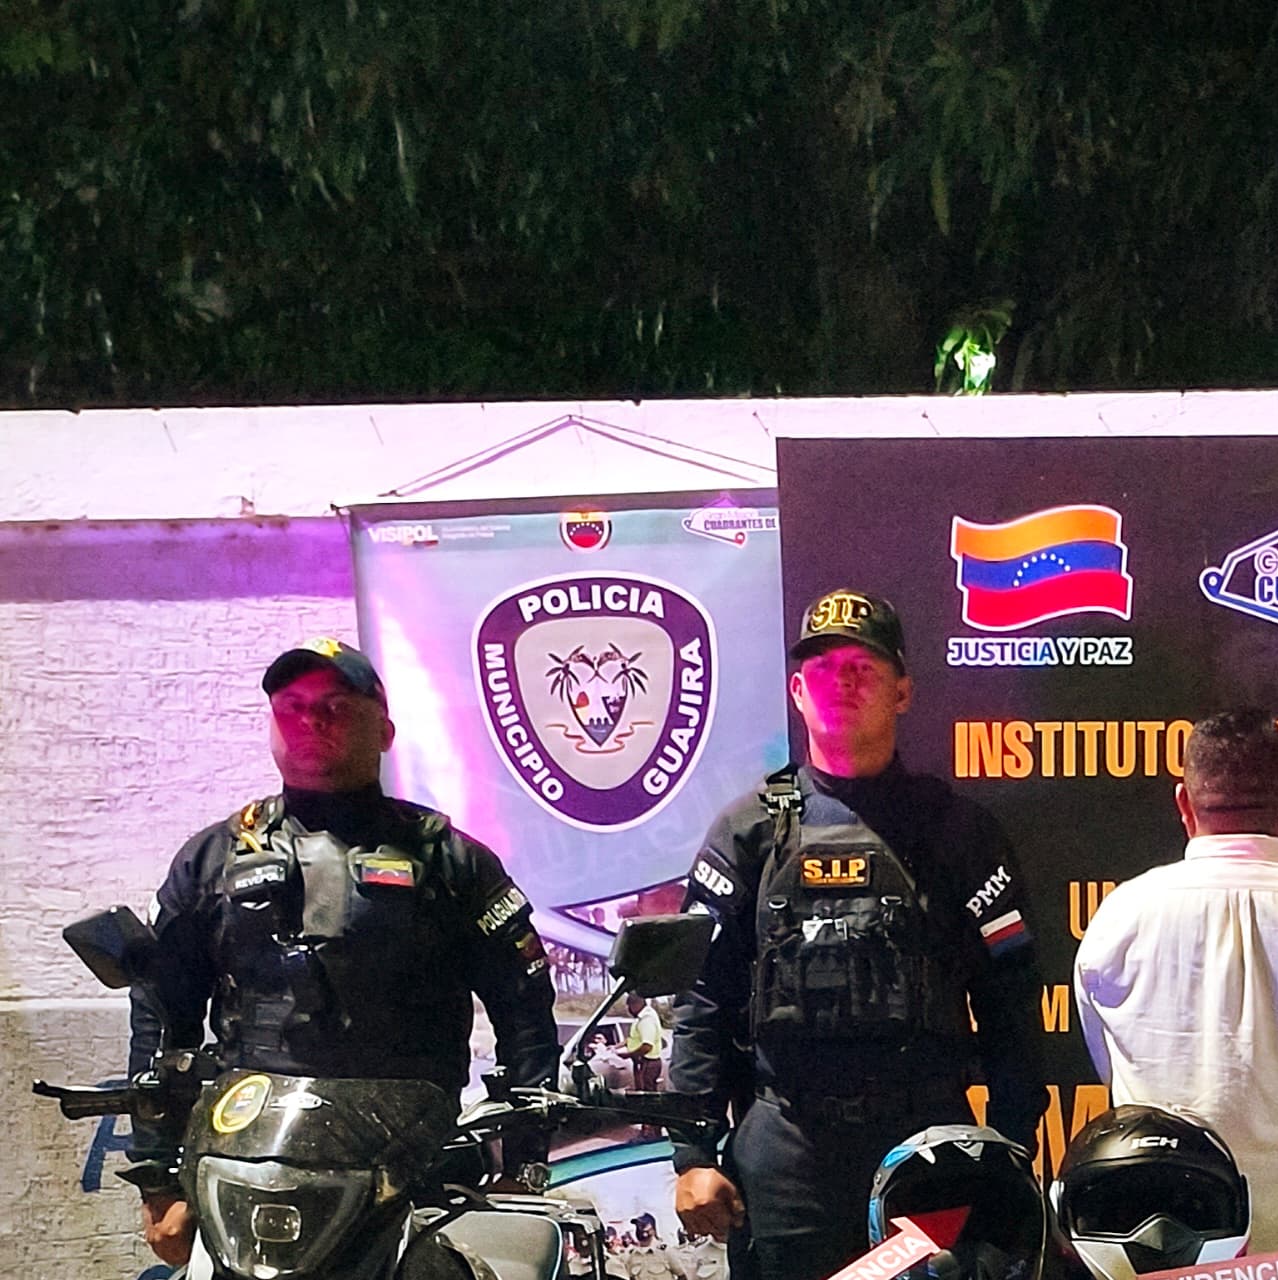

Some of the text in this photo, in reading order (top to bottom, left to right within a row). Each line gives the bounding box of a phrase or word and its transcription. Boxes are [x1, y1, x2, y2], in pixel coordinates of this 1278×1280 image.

[368, 525, 439, 543] VISIPOL
[517, 584, 665, 623] POLICIA
[809, 594, 874, 631] SIP
[949, 639, 1131, 663] JUSTICIA Y PAZ
[484, 643, 564, 801] MUNICIPIO
[642, 637, 704, 796] GUAJIRA
[694, 860, 734, 896] SIP
[803, 858, 866, 879] S.I.P
[965, 865, 1012, 918] PMM
